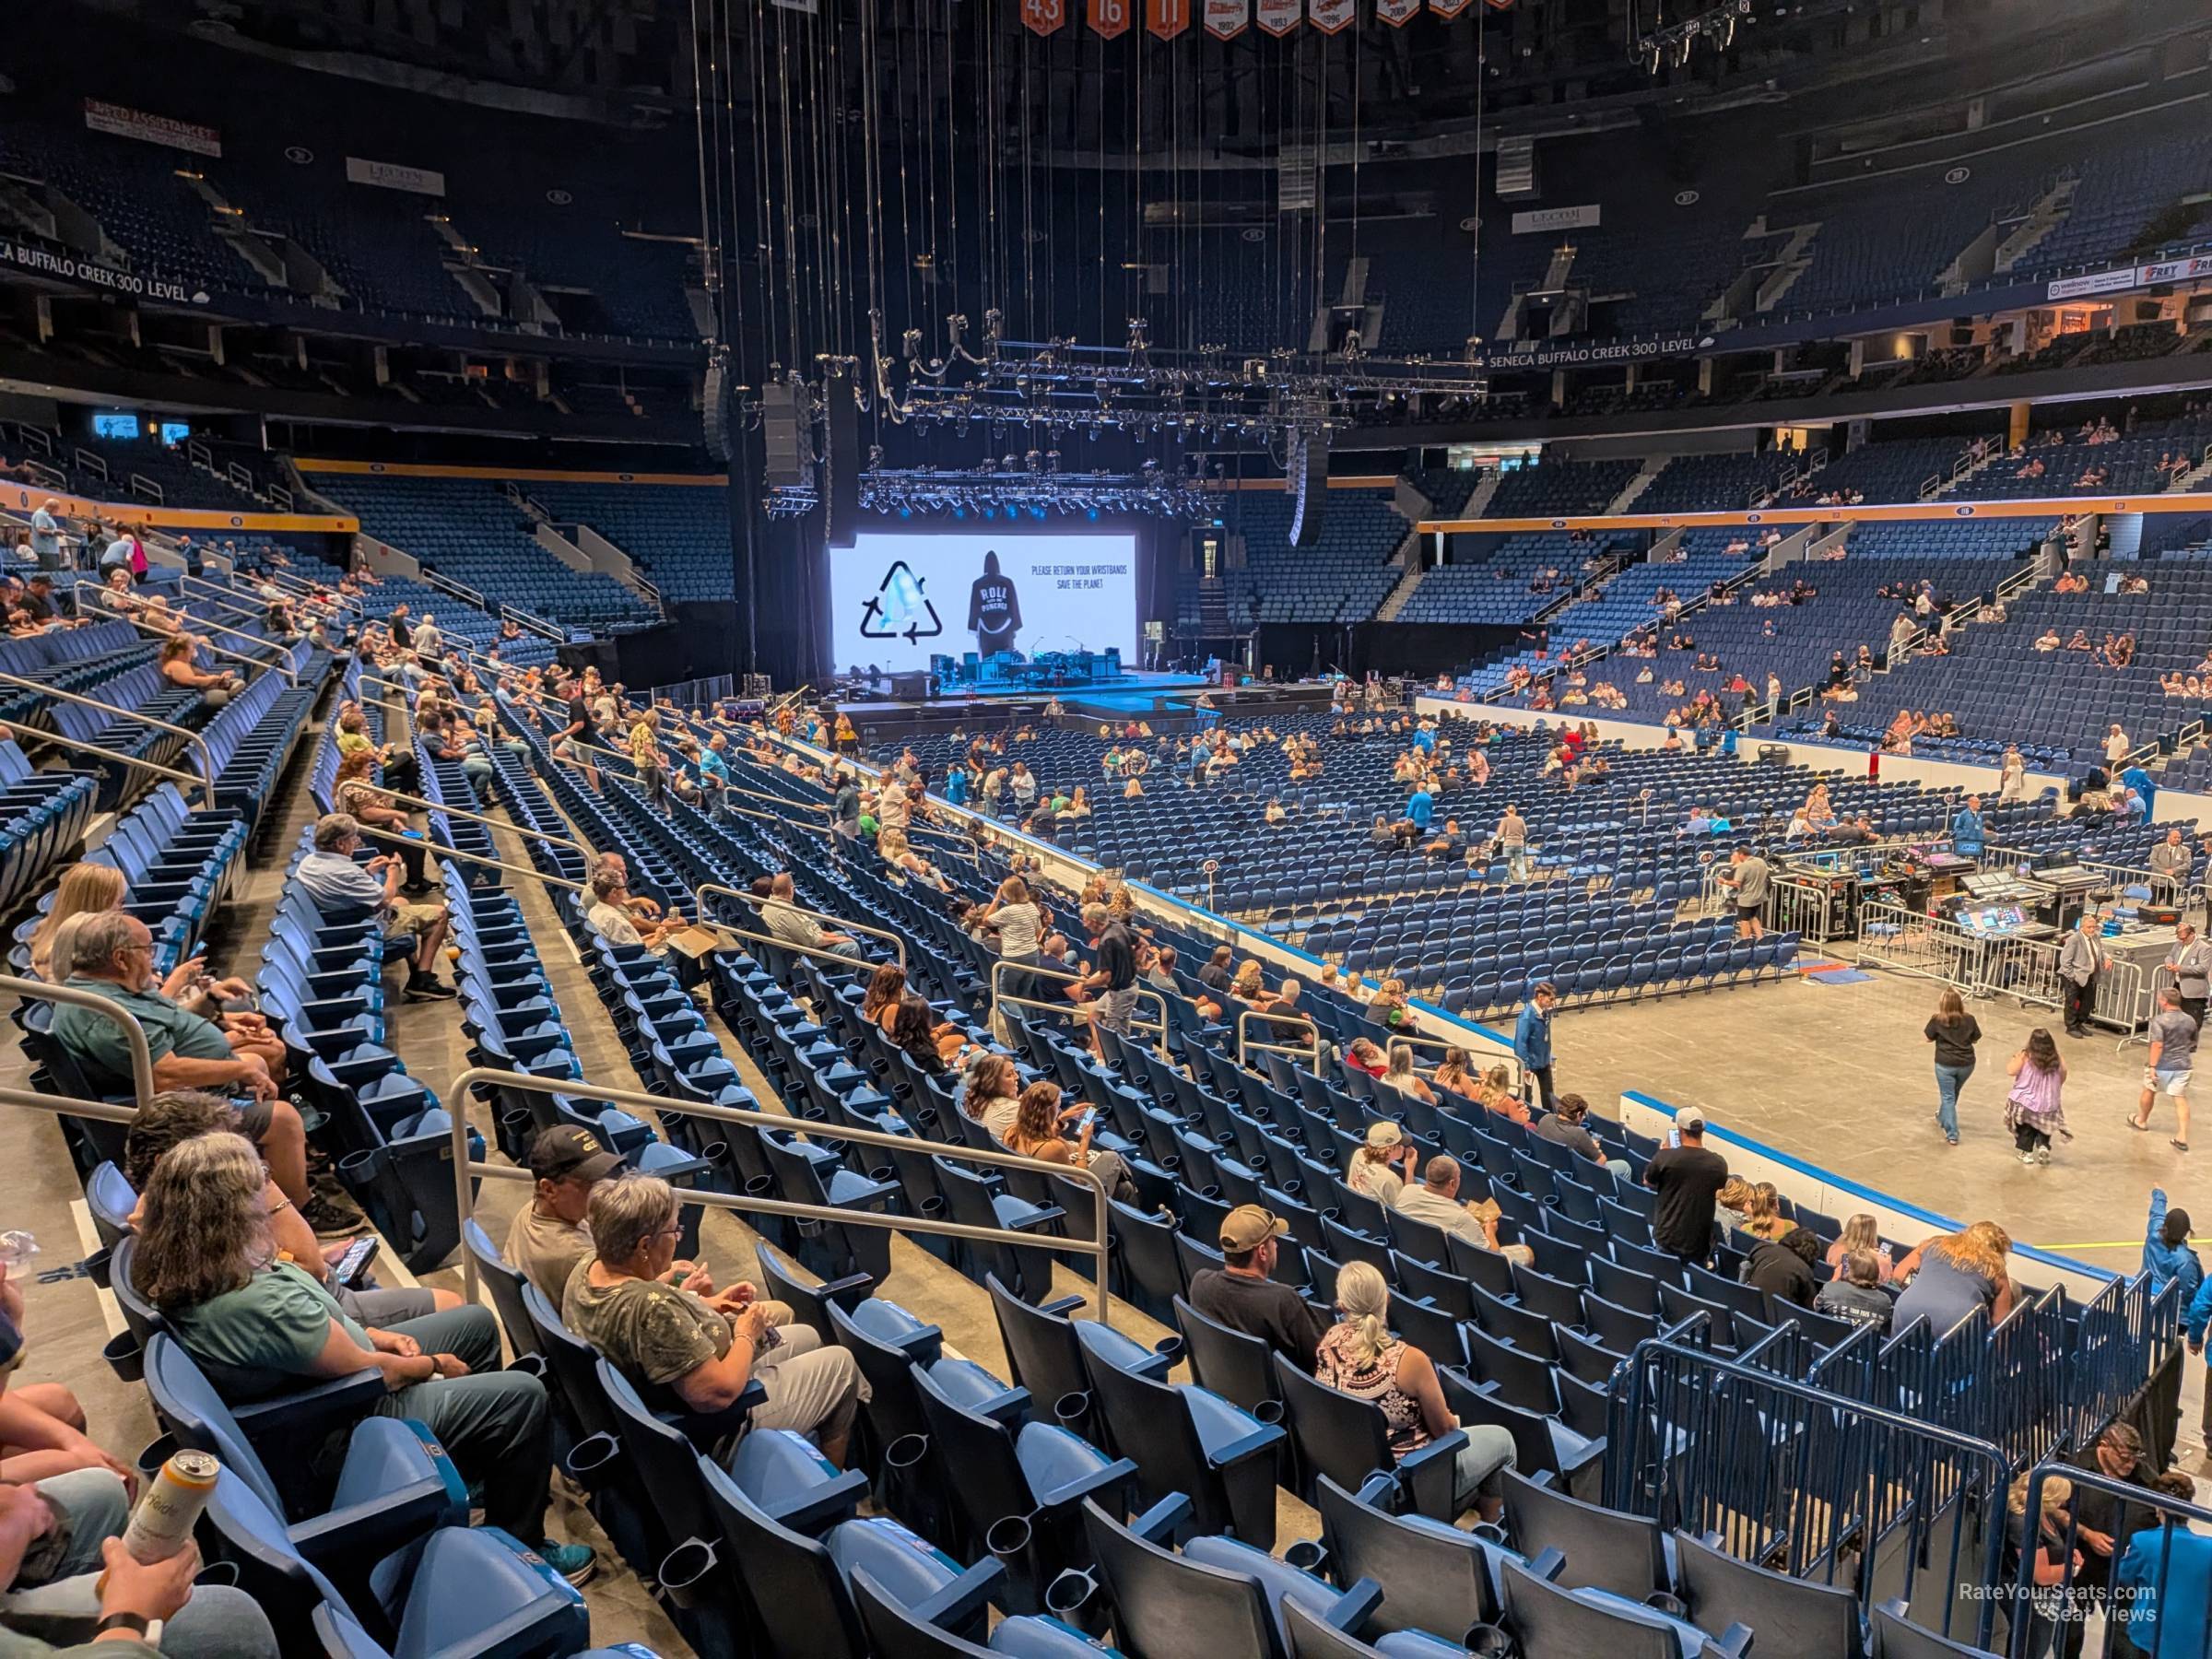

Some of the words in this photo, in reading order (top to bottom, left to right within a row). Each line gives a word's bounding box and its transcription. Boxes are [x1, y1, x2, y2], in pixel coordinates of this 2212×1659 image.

[1027, 0, 1059, 19] 43
[1100, 0, 1122, 22] 16
[1161, 0, 1178, 23] 11
[1270, 18, 1288, 28] 1993
[1323, 14, 1341, 24] 1996
[1218, 21, 1235, 30] 1992
[17, 246, 75, 276] BUFFALO
[77, 263, 115, 288] CREEK
[117, 273, 143, 294] 300
[147, 279, 189, 302] LEVEL
[2150, 265, 2179, 277] FREY
[1489, 354, 1535, 369] SENECA
[1537, 347, 1589, 365] BUFFALO
[1592, 345, 1630, 360] CREEK
[1631, 341, 1657, 356] 300
[1661, 338, 1695, 353] LEVEL
[1031, 565, 1052, 576] PLEASE
[1053, 565, 1076, 576] RETURN
[1076, 565, 1091, 575] YOUR
[1091, 564, 1127, 575] WRISTBANDS
[1056, 579, 1071, 590] SAVE
[1072, 579, 1082, 589] THE
[1083, 578, 1103, 589] PLANET
[980, 586, 1007, 601] ROLL
[1850, 1307, 1860, 1315] TOUR
